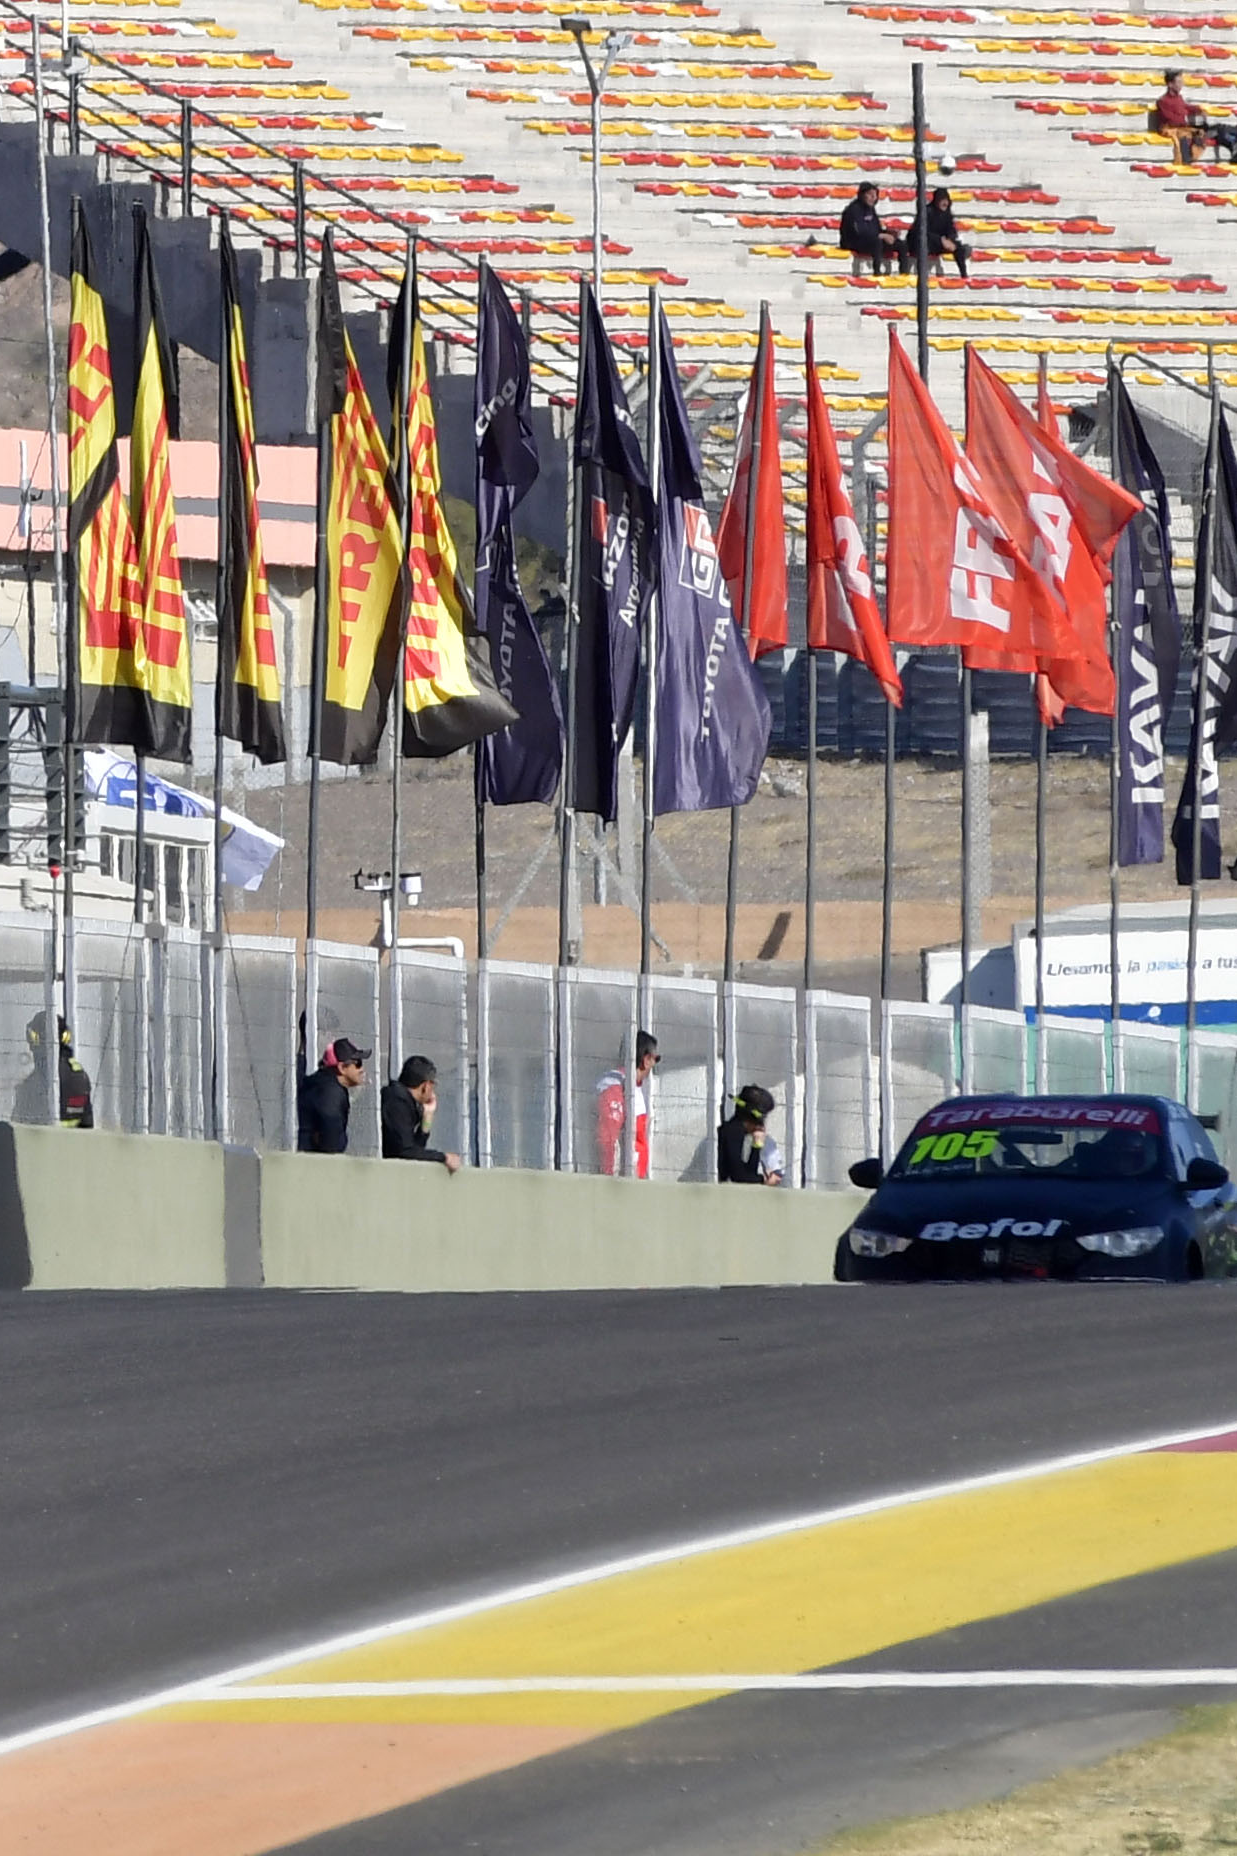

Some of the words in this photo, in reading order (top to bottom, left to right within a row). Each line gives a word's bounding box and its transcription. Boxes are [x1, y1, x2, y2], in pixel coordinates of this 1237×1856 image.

[700, 616, 731, 743] TOYOTA
[1127, 959, 1140, 973] la
[1201, 958, 1213, 970] a
[929, 1105, 1149, 1127] Taraborelli
[909, 1130, 999, 1165] 105
[919, 1218, 1063, 1242] Befol
